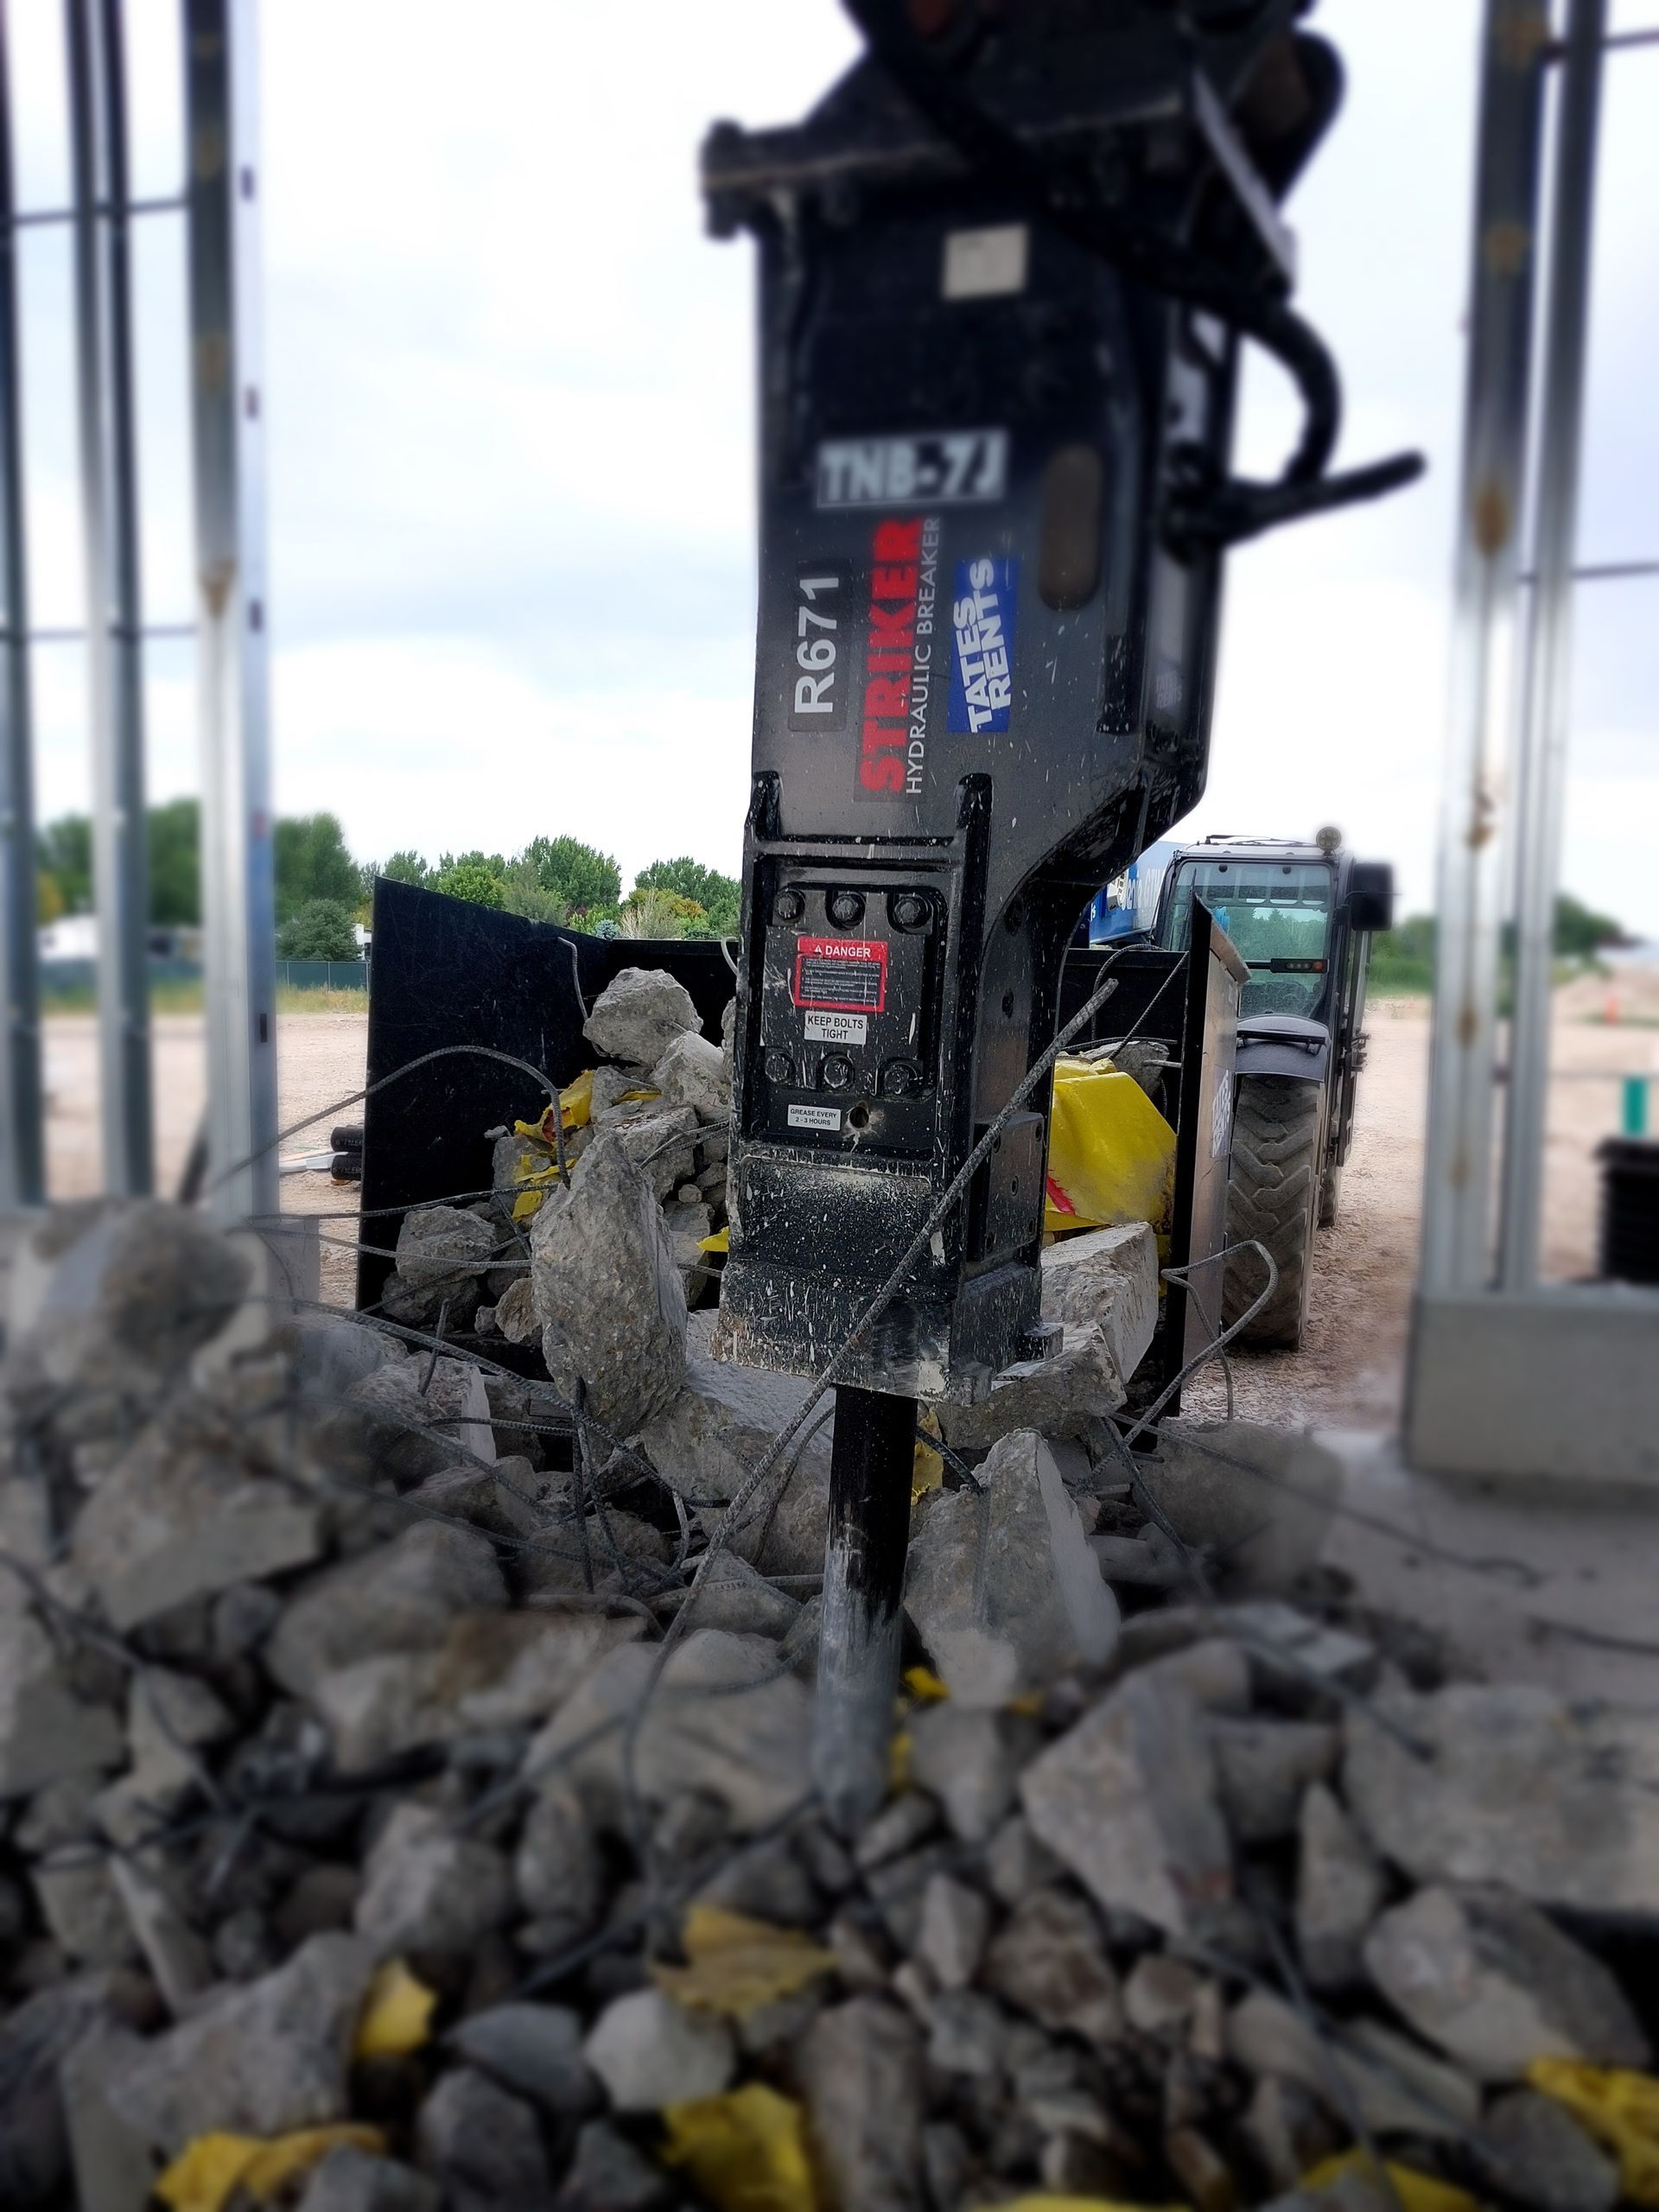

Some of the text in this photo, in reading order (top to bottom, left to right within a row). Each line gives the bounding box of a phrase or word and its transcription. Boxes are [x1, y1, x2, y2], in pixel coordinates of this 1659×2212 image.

[822, 433, 1006, 500] TNB-7J
[794, 577, 839, 714] R671
[860, 518, 923, 792] STRIKER
[906, 517, 940, 793] HYDRAULIC BREAKER
[953, 597, 993, 734] TATES
[969, 559, 1012, 710] RENTS
[825, 945, 871, 958] DANGER
[807, 1015, 864, 1029] KEEP BOLTS
[822, 1028, 849, 1039] TIGHT
[790, 1108, 837, 1119] GREASE EVERY
[809, 1117, 831, 1126] HOURS
